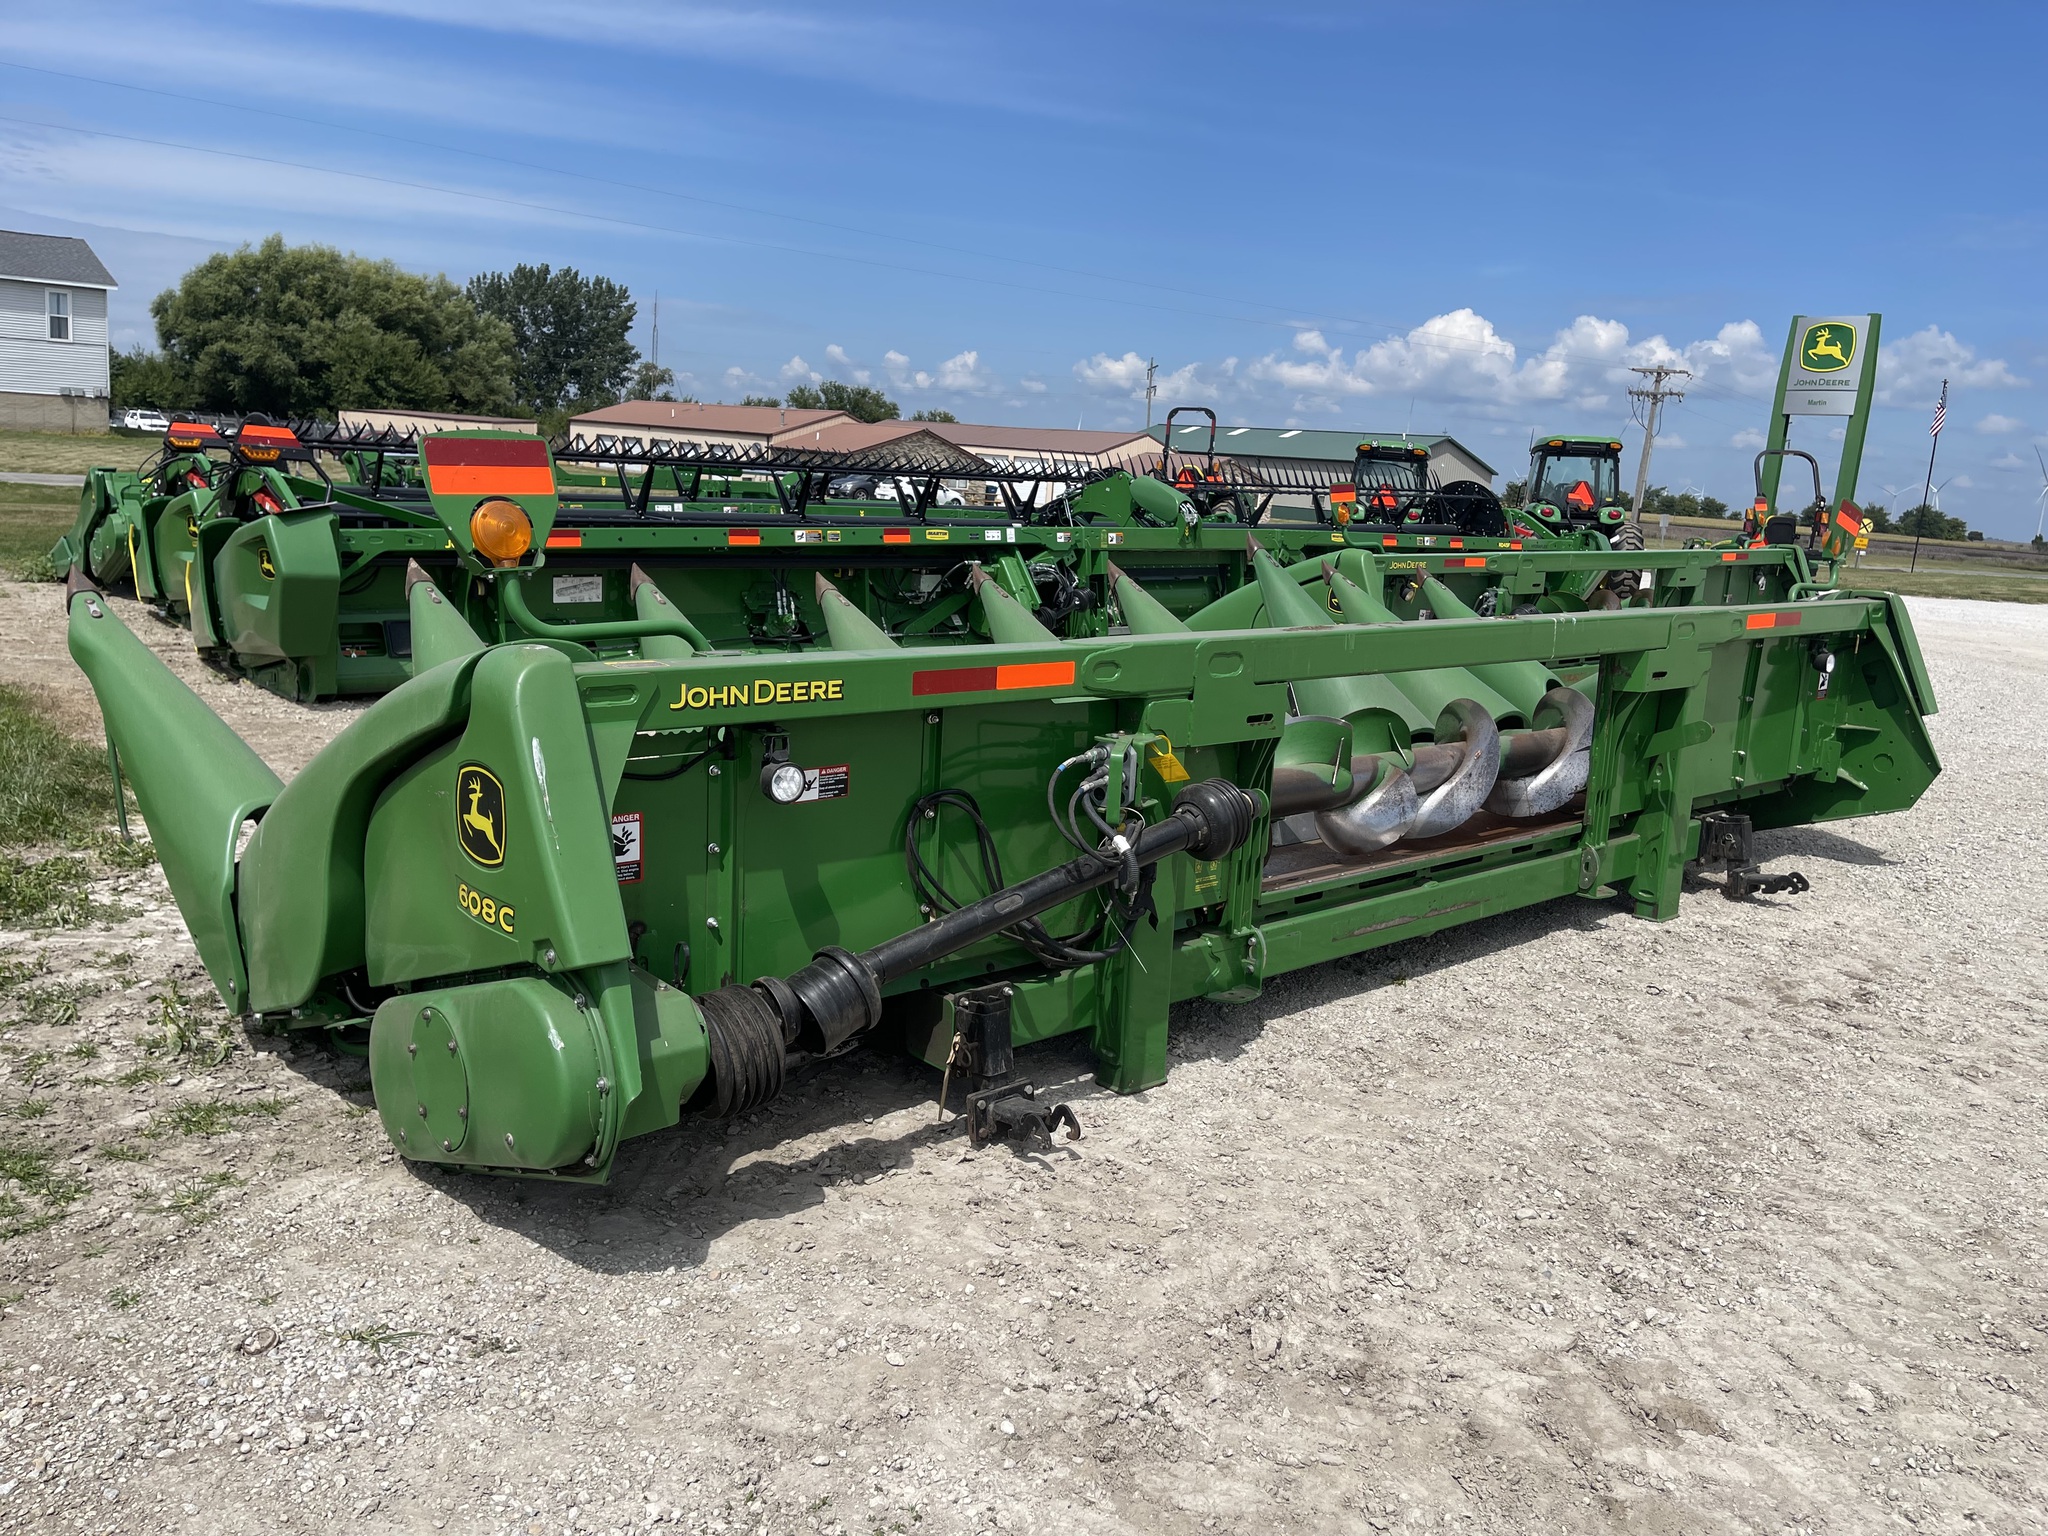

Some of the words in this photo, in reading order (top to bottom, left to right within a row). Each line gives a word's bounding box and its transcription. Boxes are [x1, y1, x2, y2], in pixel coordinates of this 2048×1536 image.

[1818, 378, 1851, 386] DEERE
[1389, 560, 1406, 569] JOHN
[669, 683, 749, 710] JOHN
[754, 679, 844, 704] DEERE
[826, 766, 847, 774] DANGER
[612, 813, 640, 823] ANGER
[458, 883, 515, 934] 608C
